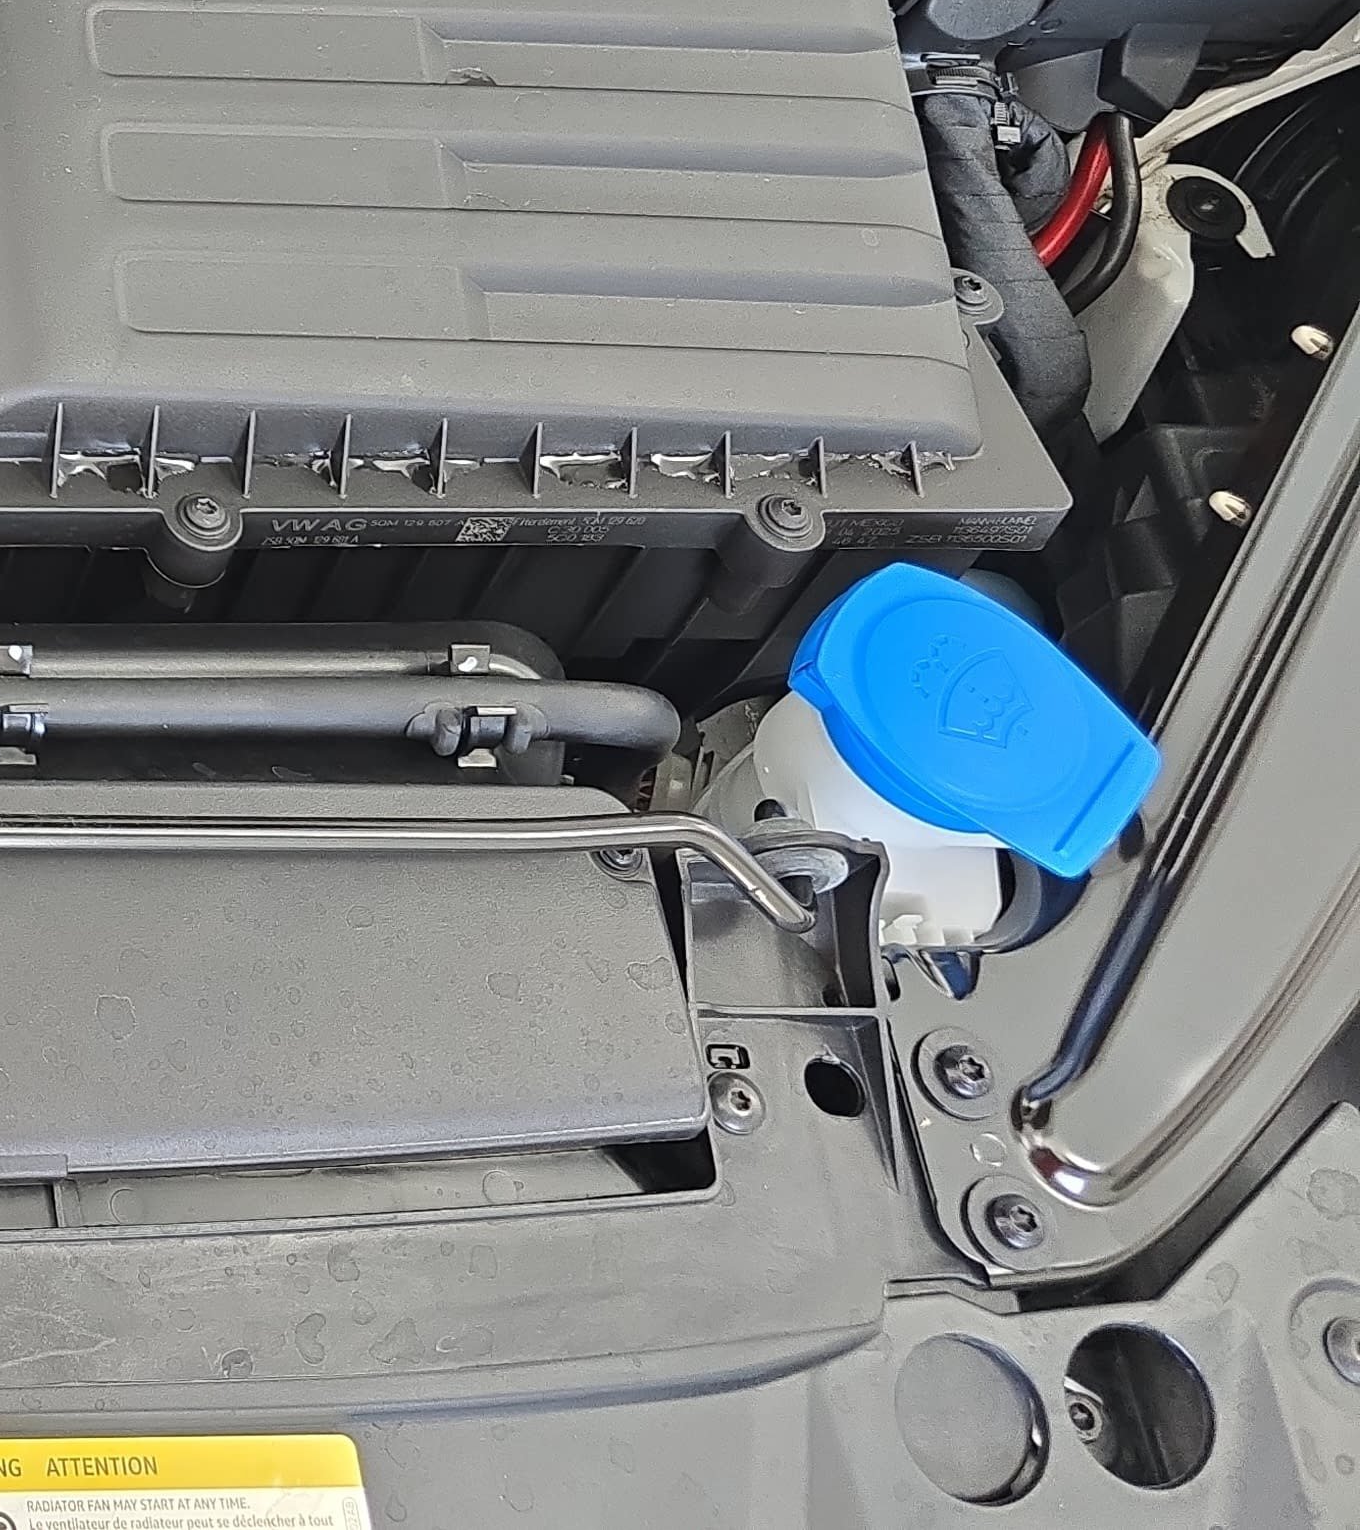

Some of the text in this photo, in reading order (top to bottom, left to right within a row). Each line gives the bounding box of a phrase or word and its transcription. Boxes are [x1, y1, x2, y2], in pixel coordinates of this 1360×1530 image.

[272, 519, 320, 532] VW
[321, 519, 367, 532] AG
[46, 1456, 158, 1477] ATTENTION
[27, 1497, 250, 1513] RADIATOR FAN MAY START AT ANY TIME.
[30, 1518, 42, 1530] Le
[45, 1517, 111, 1530] ventilateur
[113, 1517, 128, 1530] de
[131, 1516, 184, 1530] radiateur
[187, 1517, 213, 1530] peut
[215, 1519, 230, 1530] se
[232, 1515, 296, 1529] déclencher
[298, 1513, 306, 1527] à
[308, 1514, 334, 1528] tout
